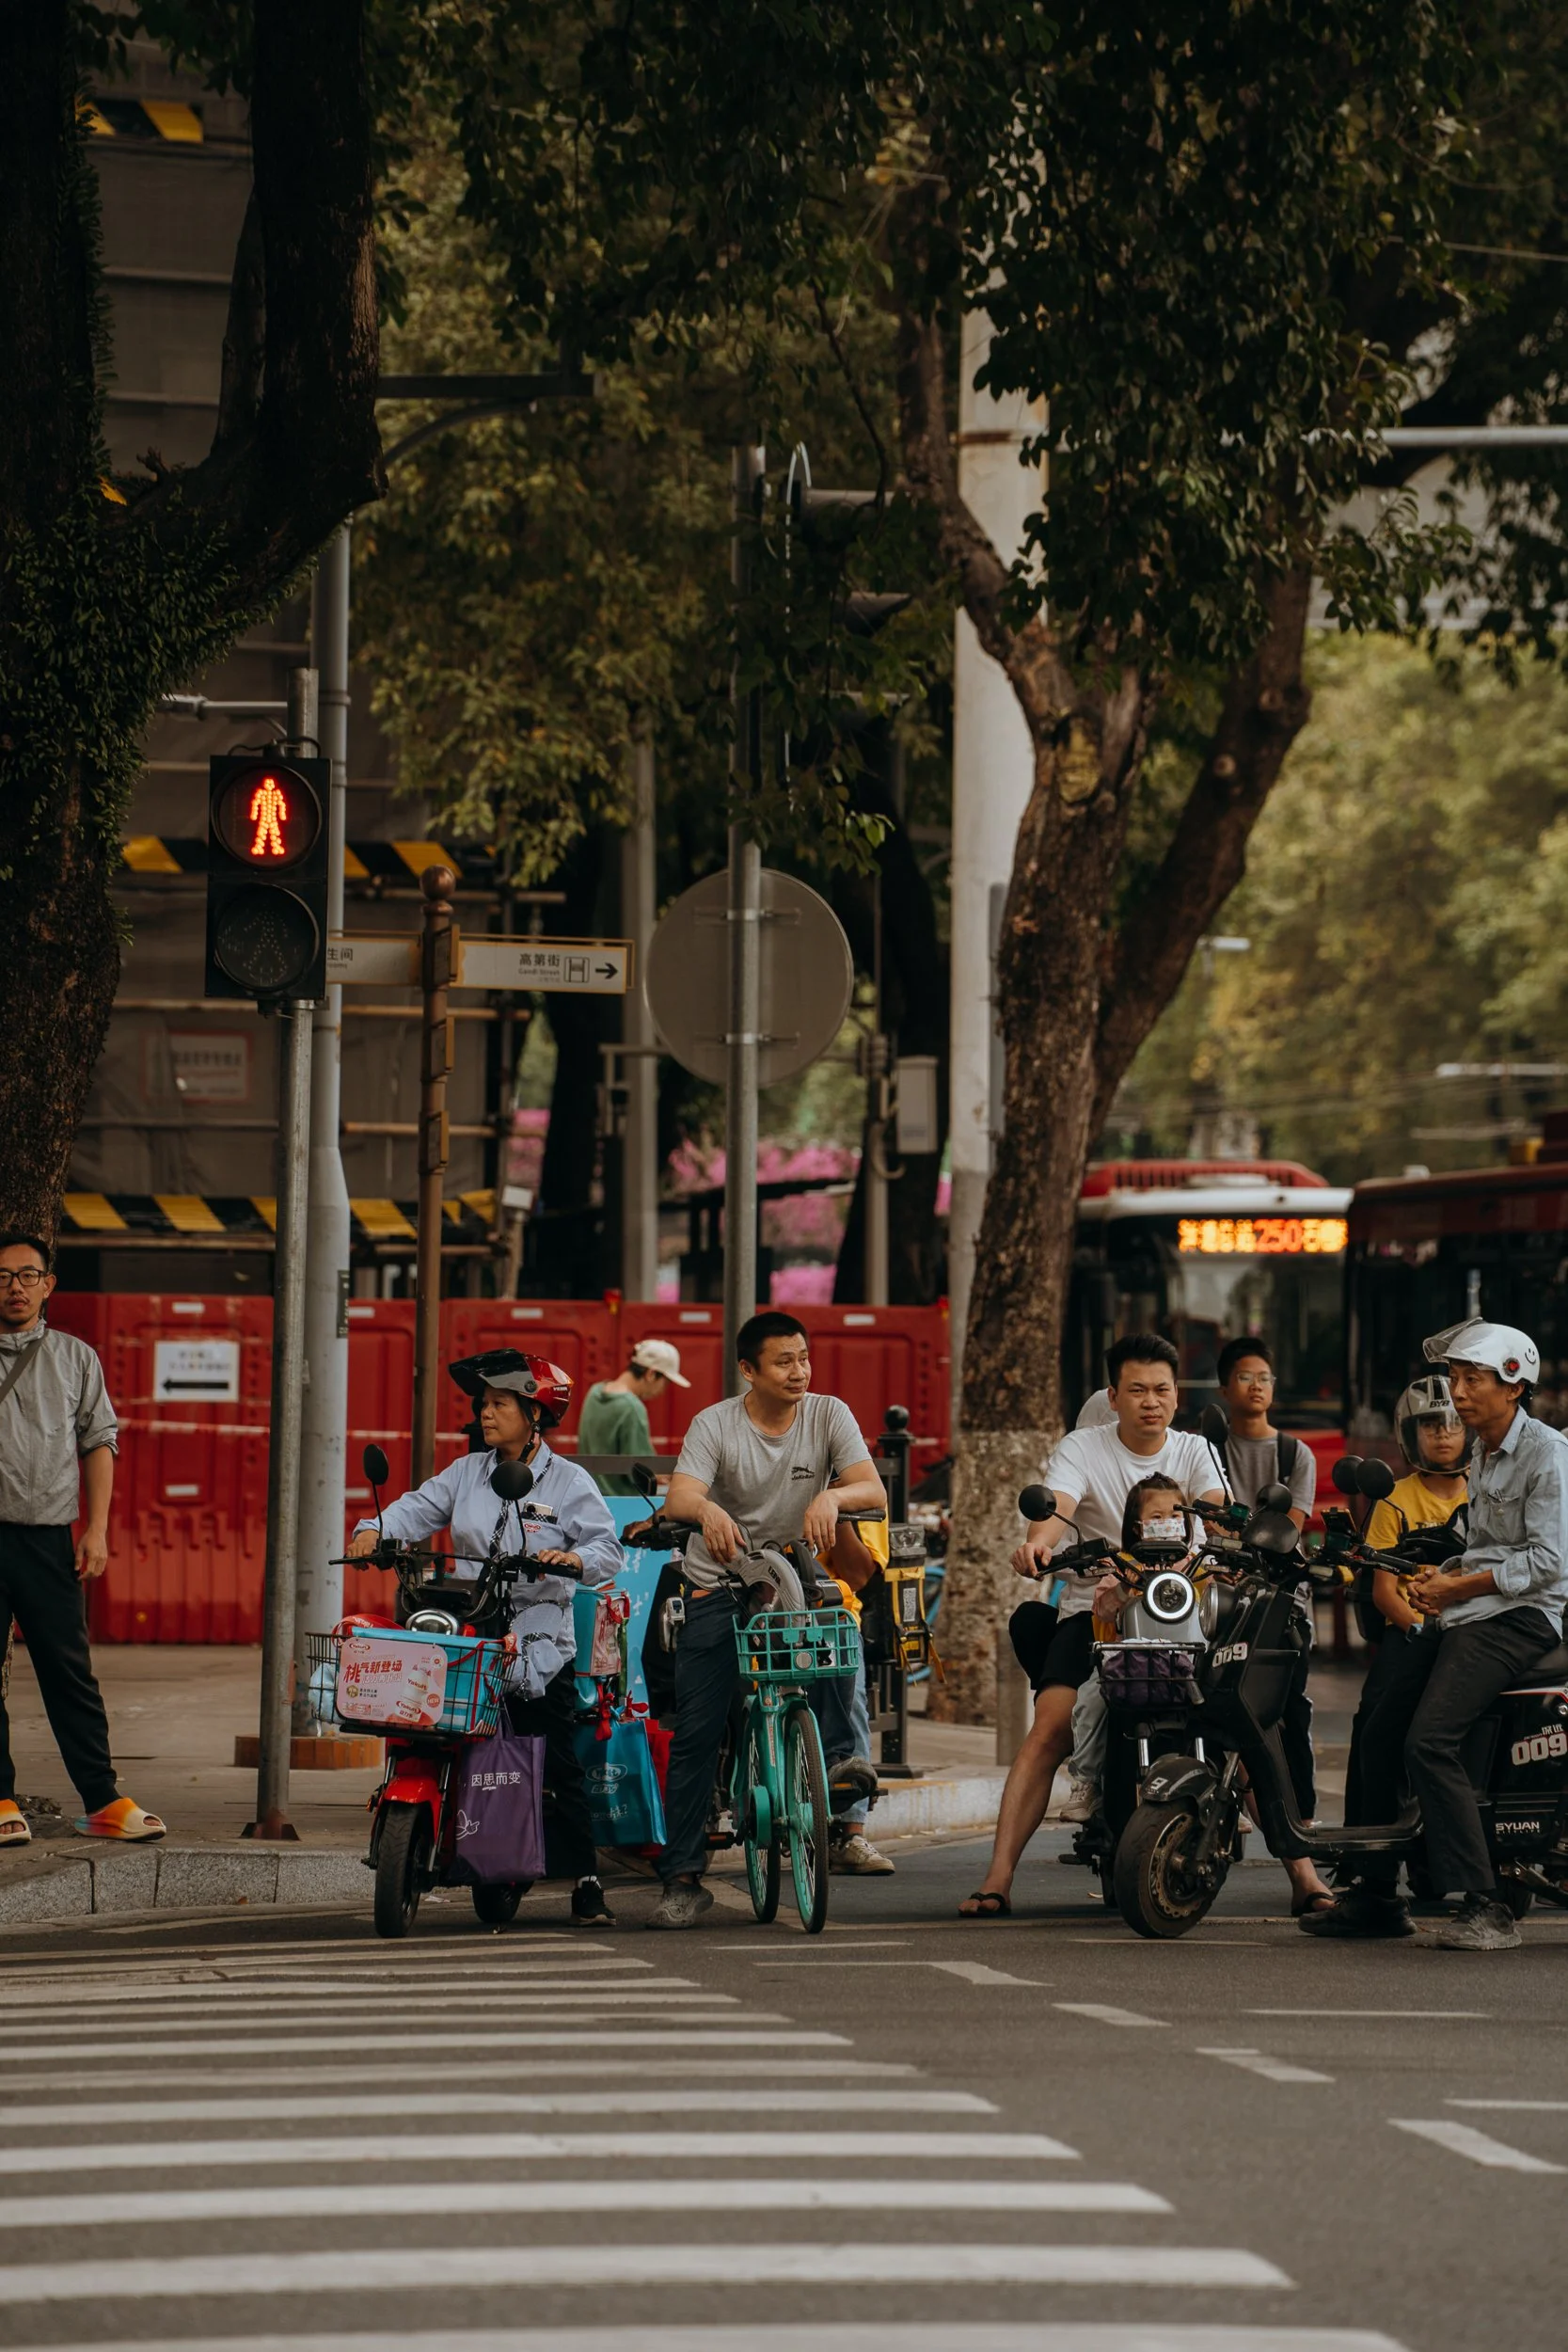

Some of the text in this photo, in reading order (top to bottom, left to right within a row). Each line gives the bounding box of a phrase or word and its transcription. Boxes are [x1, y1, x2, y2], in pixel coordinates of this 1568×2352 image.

[519, 953, 560, 967] 高第街
[1254, 1219, 1303, 1253] 250
[1212, 1642, 1247, 1668] 009
[343, 1660, 403, 1684] 桃气新登场
[407, 1677, 427, 1691] Yakult
[1512, 1732, 1568, 1766] 009
[471, 1771, 521, 1787] 因思而变
[1496, 1821, 1540, 1831] SYUAN
